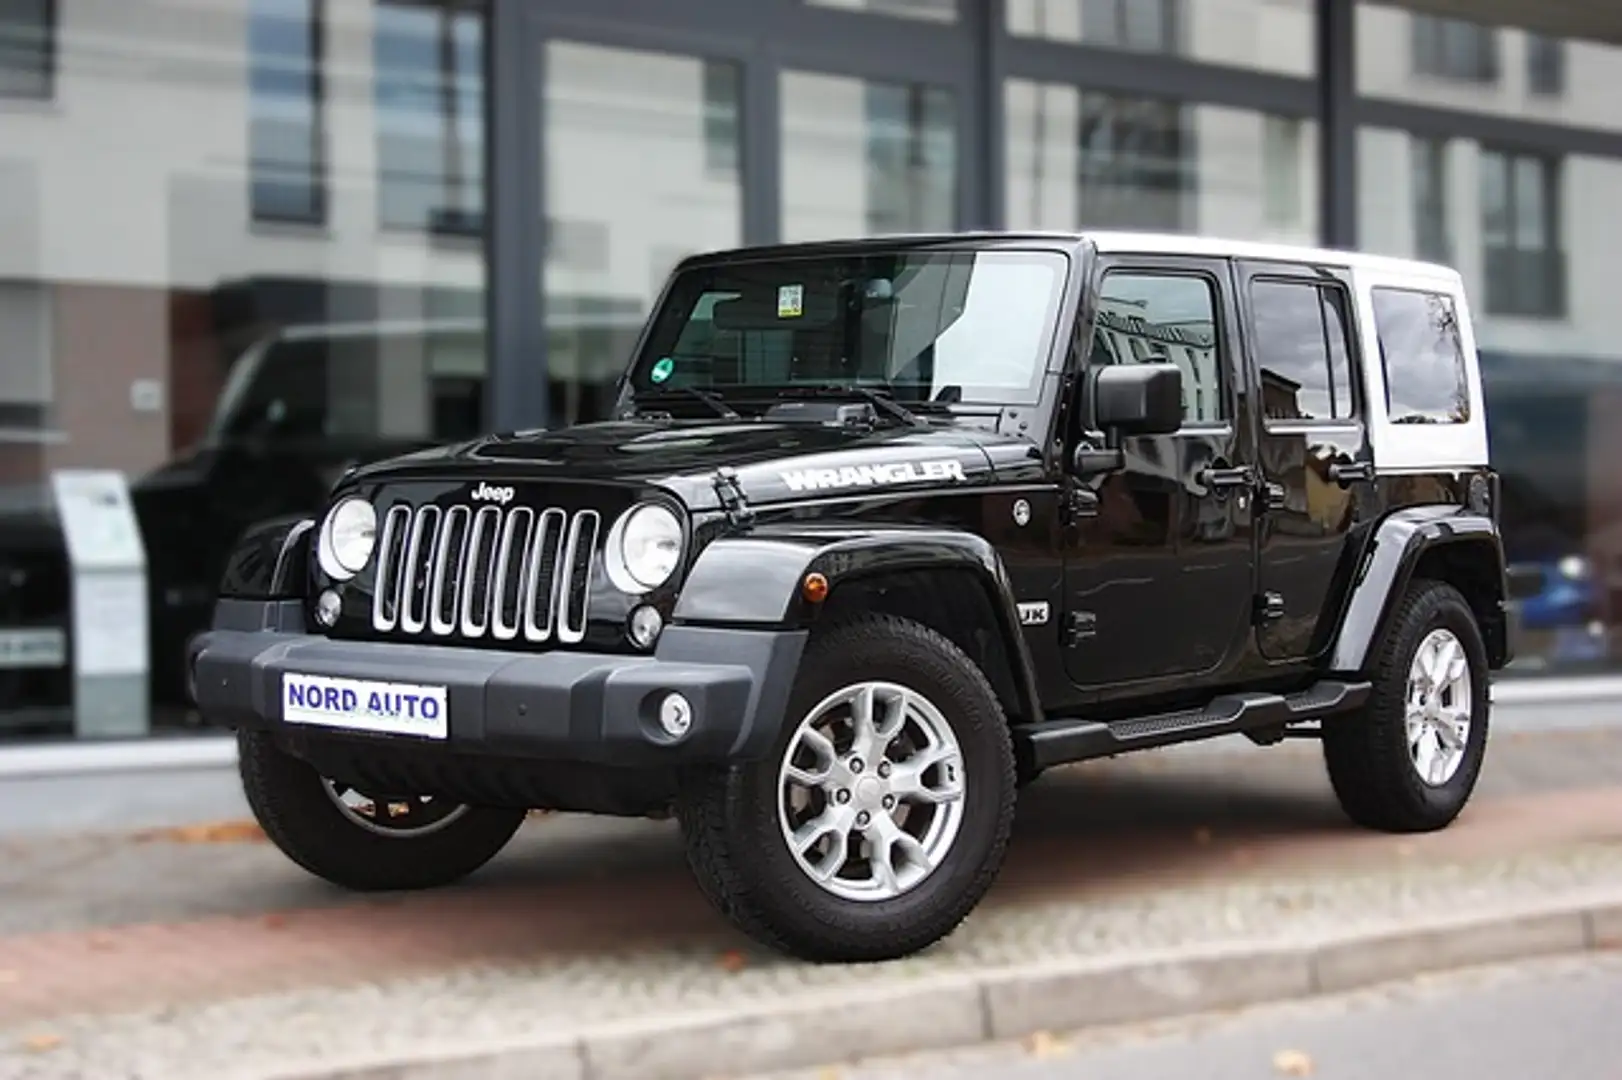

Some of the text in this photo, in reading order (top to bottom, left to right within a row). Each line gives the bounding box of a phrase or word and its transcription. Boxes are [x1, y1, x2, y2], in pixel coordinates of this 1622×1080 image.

[780, 458, 968, 492] WRANGLER
[471, 481, 515, 505] Jeep
[288, 682, 440, 720] NORD AUTO
